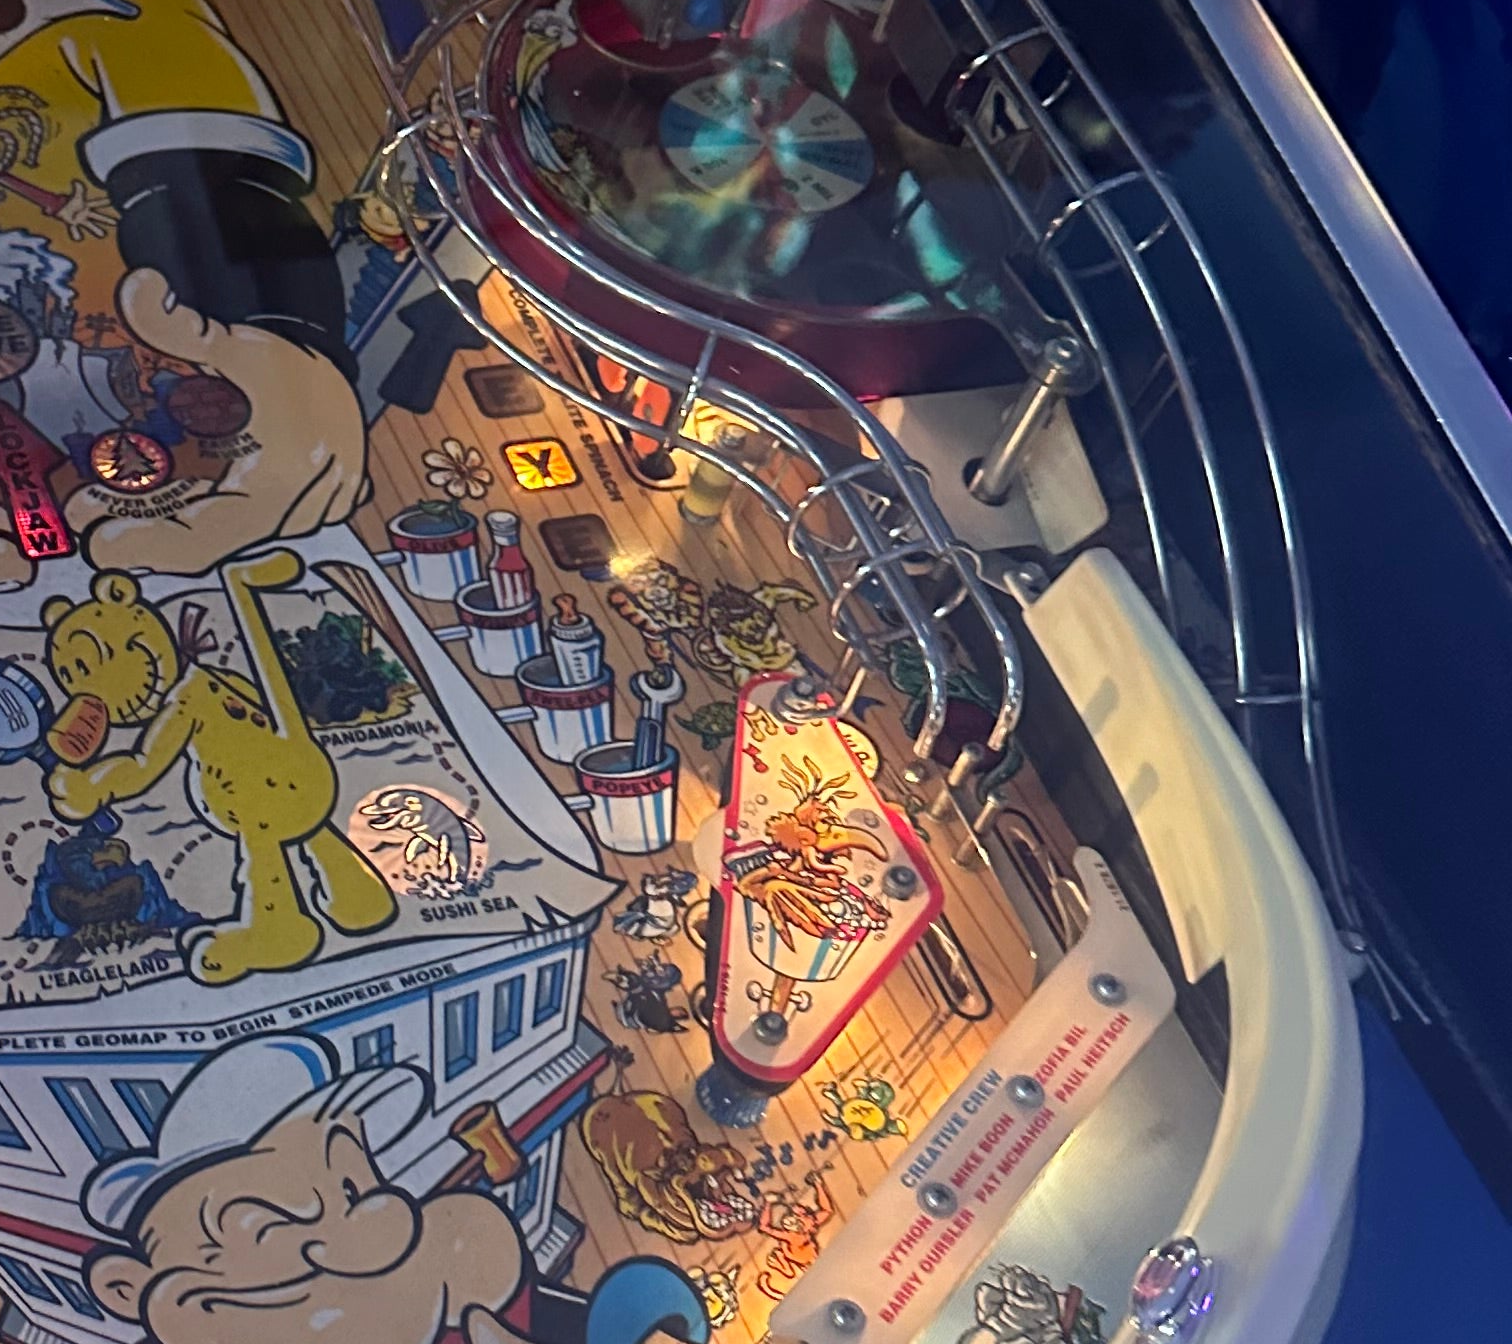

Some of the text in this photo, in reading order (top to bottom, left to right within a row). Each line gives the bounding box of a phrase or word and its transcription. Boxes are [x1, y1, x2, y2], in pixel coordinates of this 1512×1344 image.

[508, 288, 556, 366] COMPLETE
[578, 430, 625, 504] SPINACH
[517, 448, 551, 480] Y
[87, 476, 201, 508] NEVER GREEN
[107, 498, 190, 519] LOGGING
[318, 719, 439, 749] PANDAMONIA
[592, 774, 669, 795] POPEYE
[419, 896, 519, 923] SUSHI SEA
[39, 956, 170, 990] L'EAGLELAND
[75, 1032, 169, 1048] GEOMAP
[176, 1030, 206, 1044] TO
[212, 1013, 278, 1043] BEGIN
[288, 980, 394, 1020] STAMPEDE
[399, 962, 457, 988] MODE
[900, 1068, 1004, 1189] CREATIVE CREW
[878, 1213, 935, 1276] PYTHON
[949, 1148, 985, 1190] MIKE
[980, 1112, 1015, 1154] BOON
[1034, 1044, 1071, 1086] ZOFIA
[878, 1270, 925, 1325] BARRY
[919, 1209, 976, 1275] OURSLER
[974, 1171, 1005, 1205] PAT
[1054, 1068, 1089, 1104] PAUL
[1080, 1011, 1132, 1068] HEITSCH
